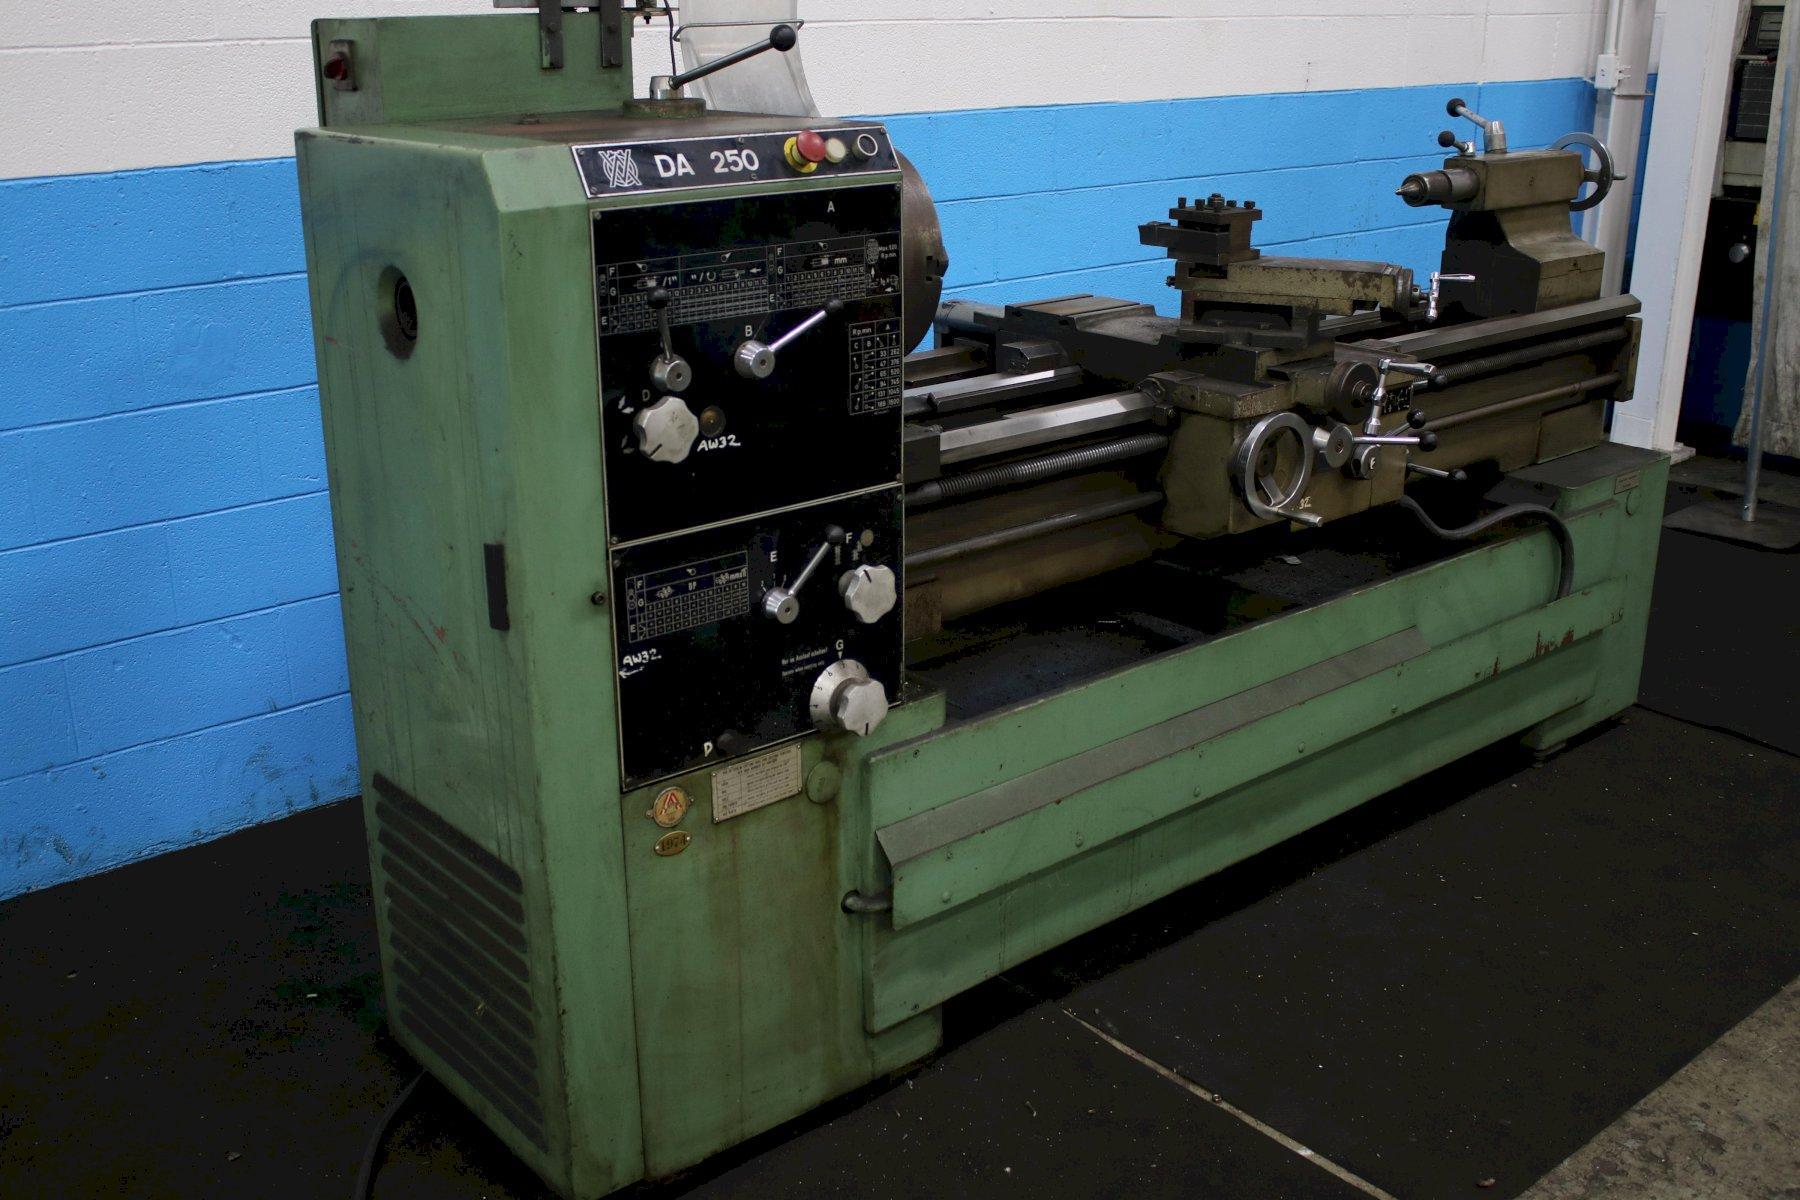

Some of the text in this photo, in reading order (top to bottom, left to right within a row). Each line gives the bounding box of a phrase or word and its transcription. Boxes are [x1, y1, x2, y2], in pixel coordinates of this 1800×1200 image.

[653, 149, 760, 178] DA 250
[827, 201, 835, 213] A
[601, 316, 608, 326] E
[745, 325, 753, 337] B
[642, 389, 650, 401] D
[697, 434, 741, 452] AW32
[845, 532, 853, 544] F
[770, 550, 778, 563] E
[835, 639, 844, 651] G
[622, 648, 662, 667] AW32
